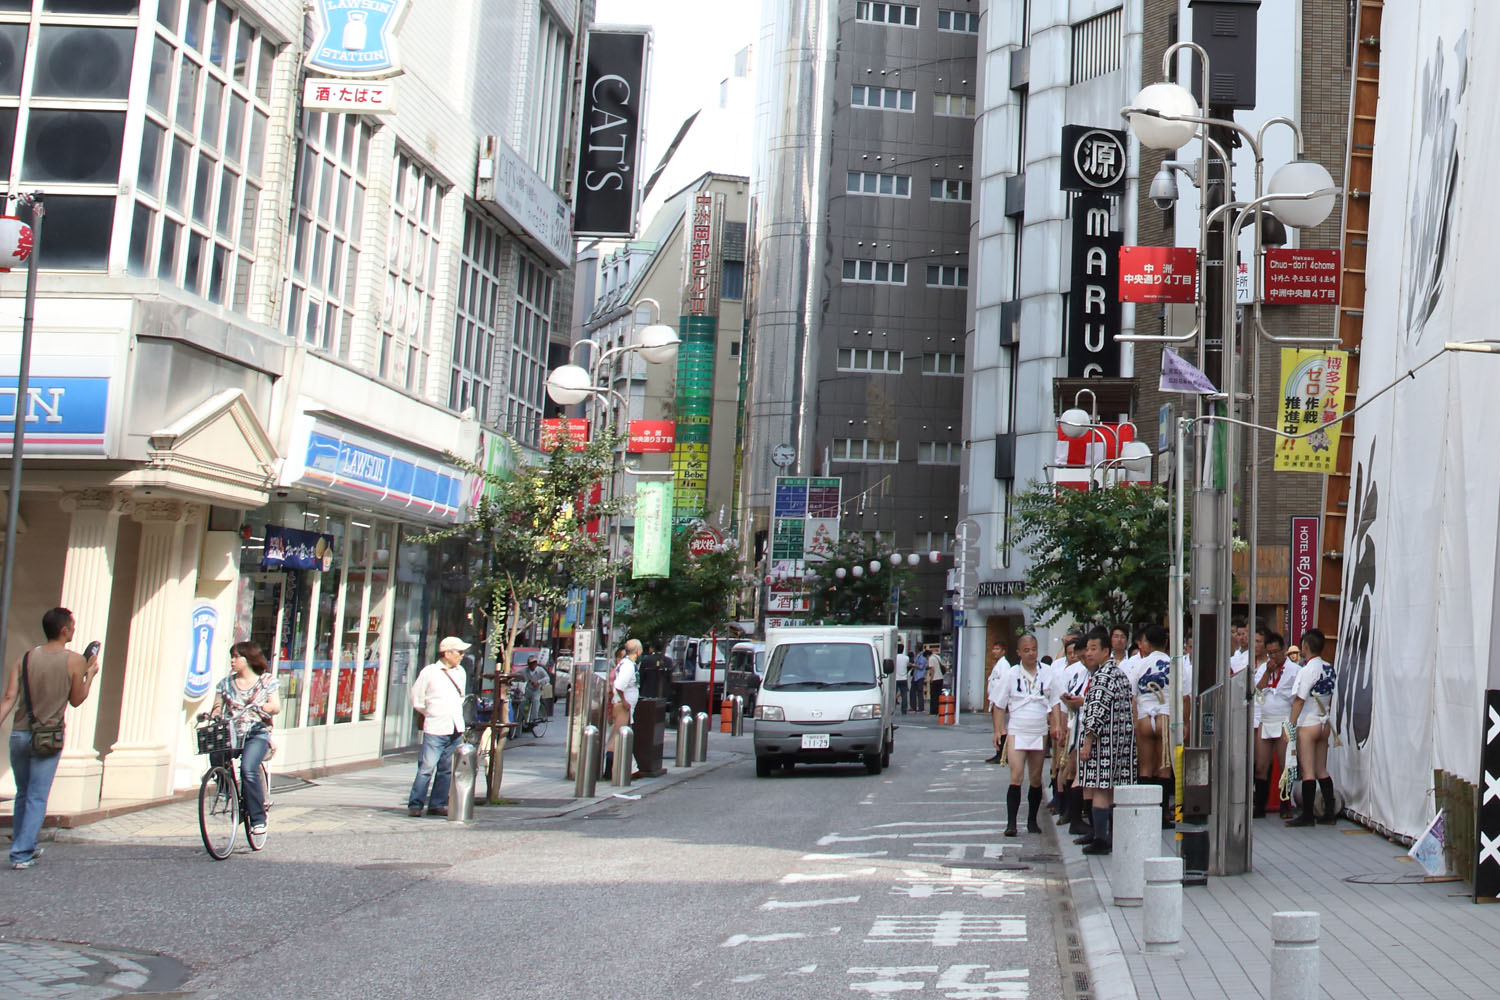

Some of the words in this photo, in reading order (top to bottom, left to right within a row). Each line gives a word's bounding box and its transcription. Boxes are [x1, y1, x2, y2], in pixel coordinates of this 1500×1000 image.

[321, 47, 385, 62] STATION
[585, 74, 630, 191] CAT'S
[1079, 134, 1122, 184] 源
[1270, 260, 1307, 269] Chuo-dori
[1309, 261, 1335, 269] 4chome
[1302, 368, 1323, 424] ゼロ作戦
[342, 448, 386, 482] LAWSON
[684, 471, 704, 479] Bebe
[1299, 525, 1309, 554] HOTEL
[1296, 555, 1313, 593] RESOL
